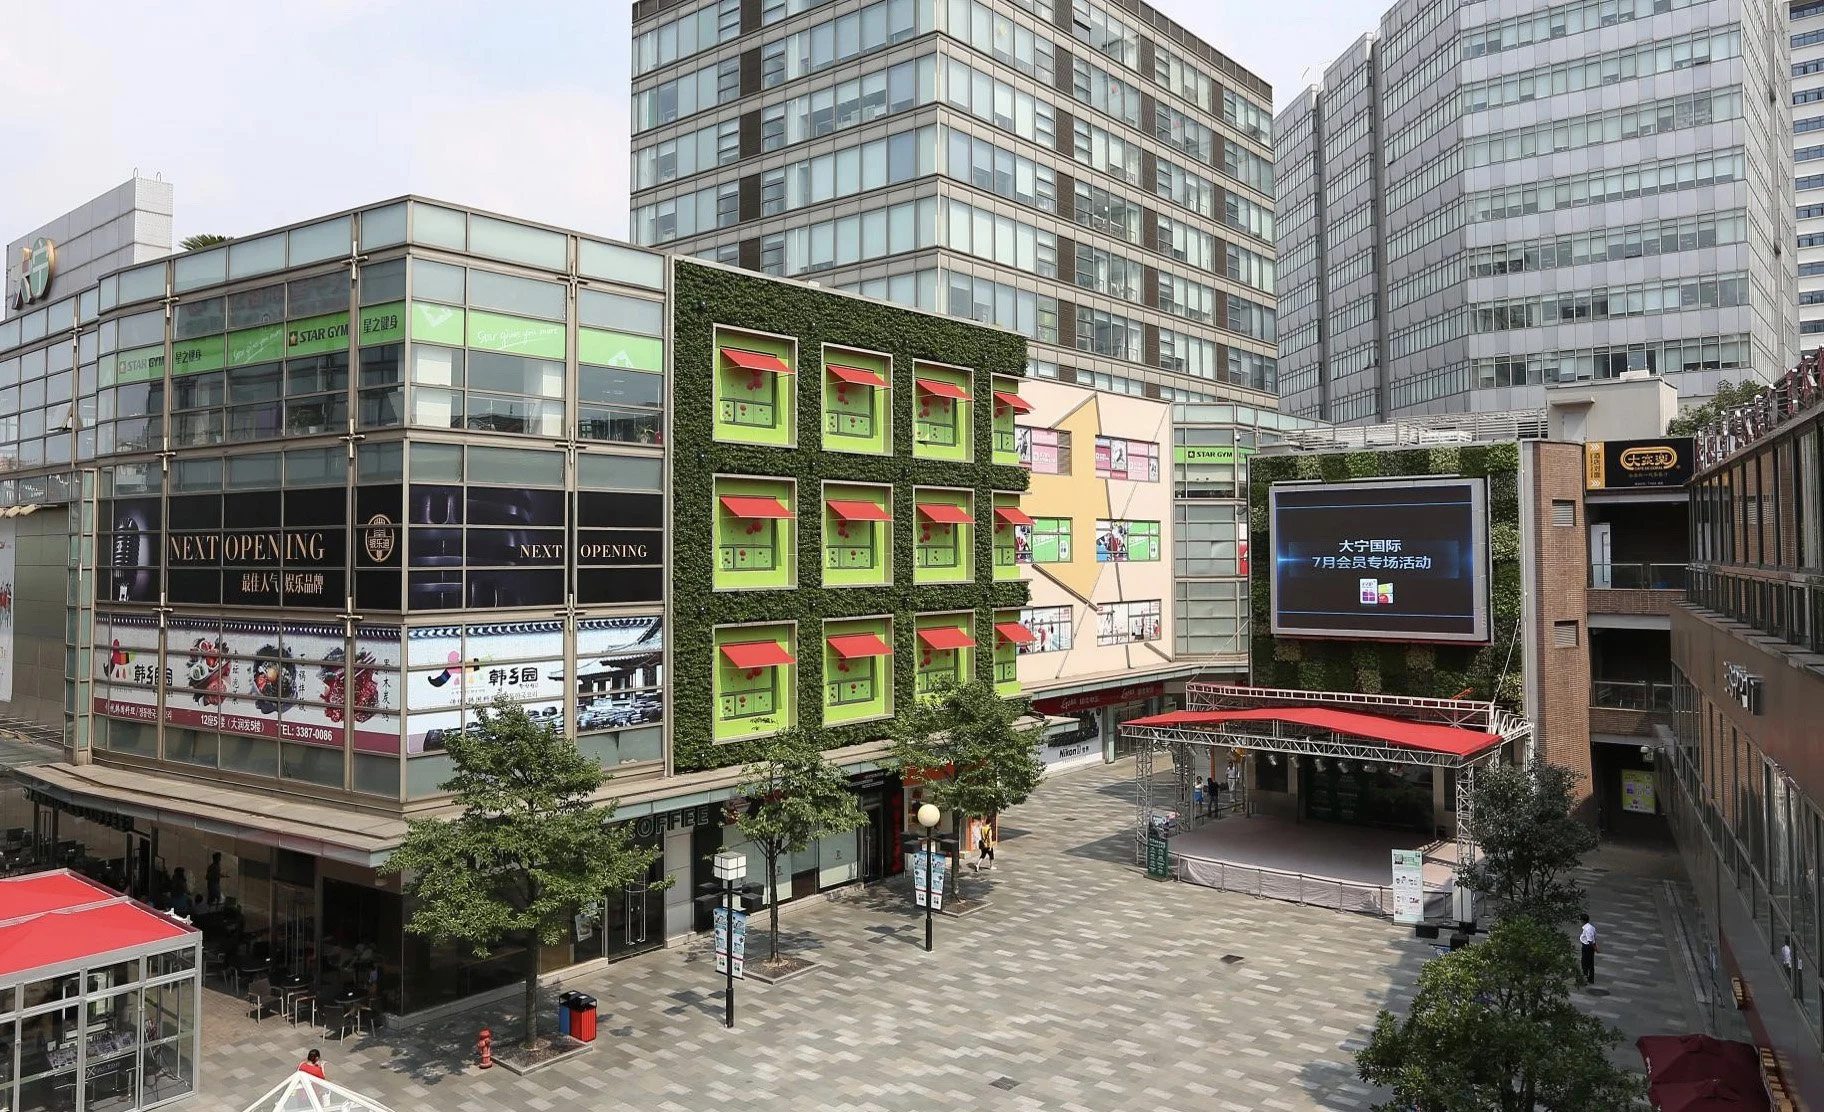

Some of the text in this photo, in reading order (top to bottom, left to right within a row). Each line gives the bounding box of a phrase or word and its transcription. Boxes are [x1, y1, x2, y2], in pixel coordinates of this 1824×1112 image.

[363, 315, 398, 333] 星之健身
[300, 324, 349, 343] STAR GYM
[127, 359, 148, 372] STAR
[170, 532, 325, 561] NEXT OPENING
[519, 544, 648, 558] NEXT OPENING
[1339, 539, 1402, 553] 大宁国际
[1311, 555, 1432, 569] 7月会员专场活动
[488, 667, 538, 687] 韩乡园
[296, 726, 333, 742] 3387-0086
[628, 805, 709, 840] OFFEE
